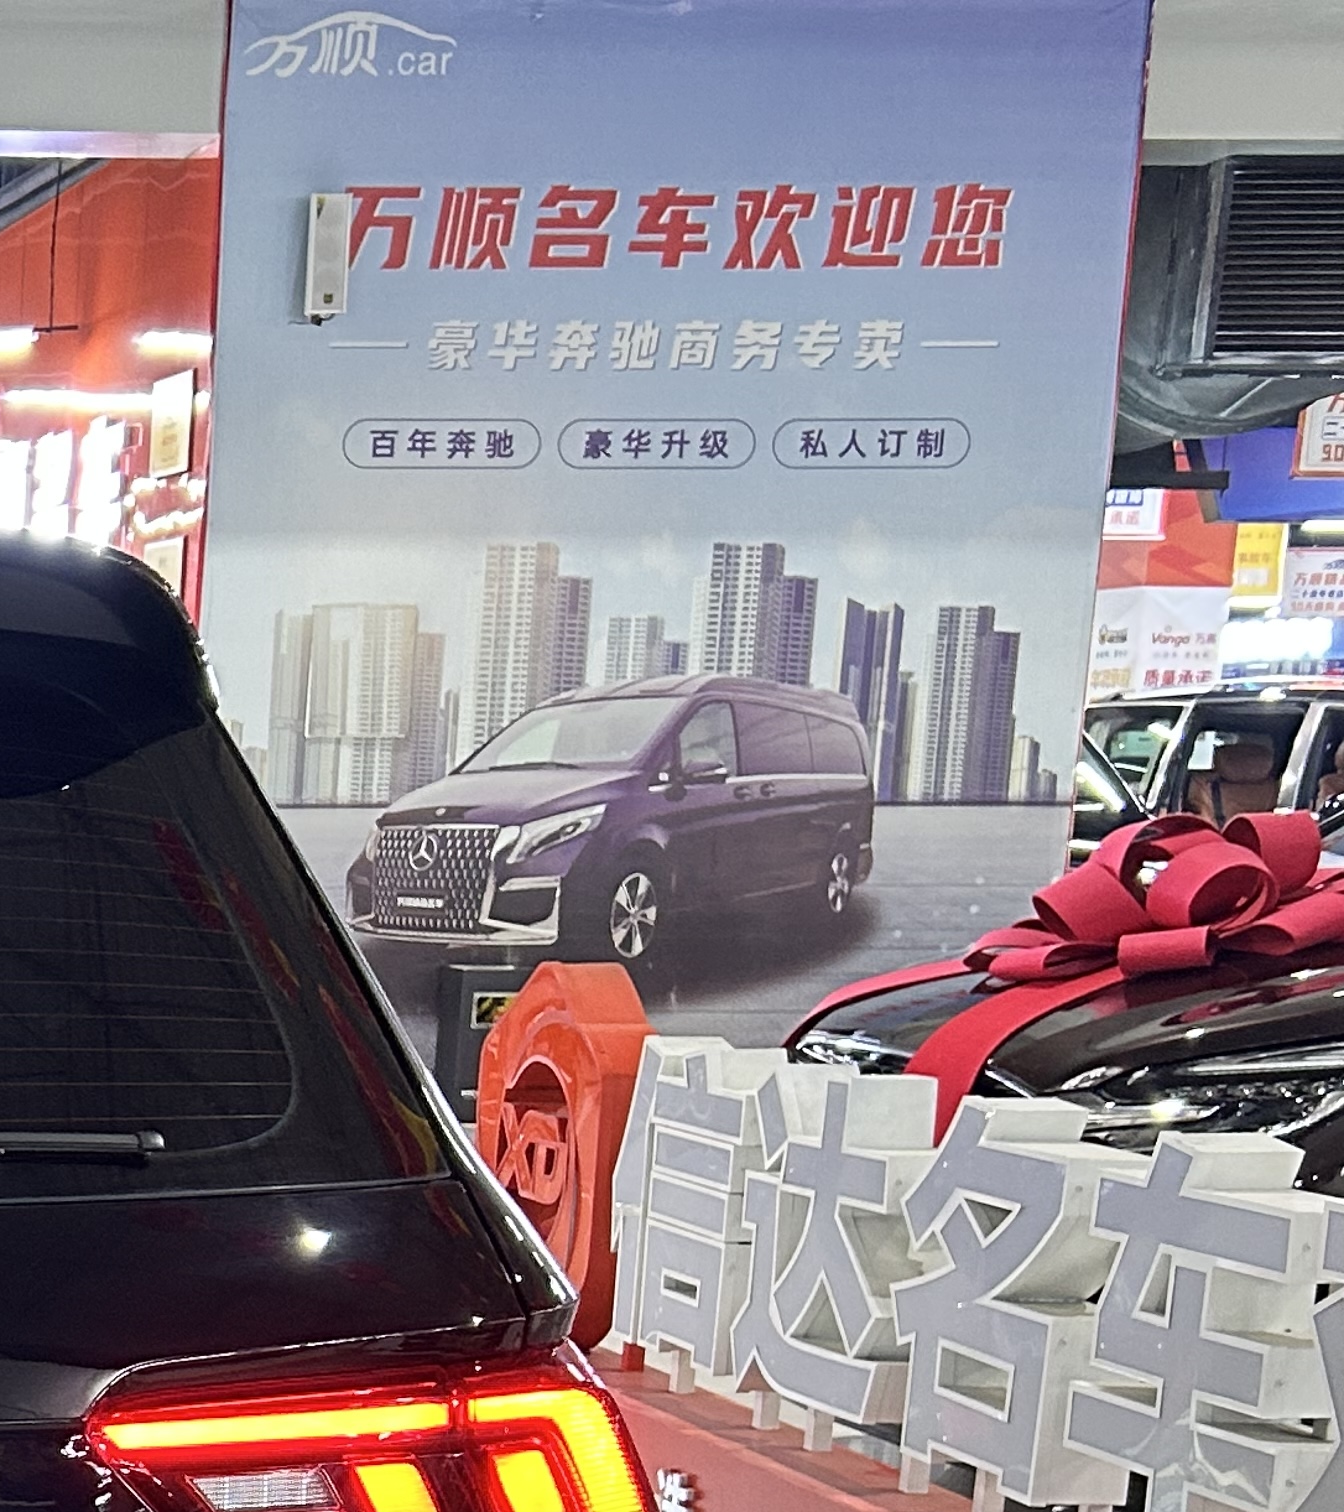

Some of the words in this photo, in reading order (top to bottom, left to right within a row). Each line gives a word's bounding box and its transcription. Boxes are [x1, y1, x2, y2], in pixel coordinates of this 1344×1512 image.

[347, 182, 1015, 270] 万顺名车欢迎您
[427, 319, 906, 372] 豪华奔驰商务专卖
[370, 429, 515, 459] 百年奔驰
[583, 429, 730, 459] 豪华升级
[799, 429, 947, 459] 私人订制
